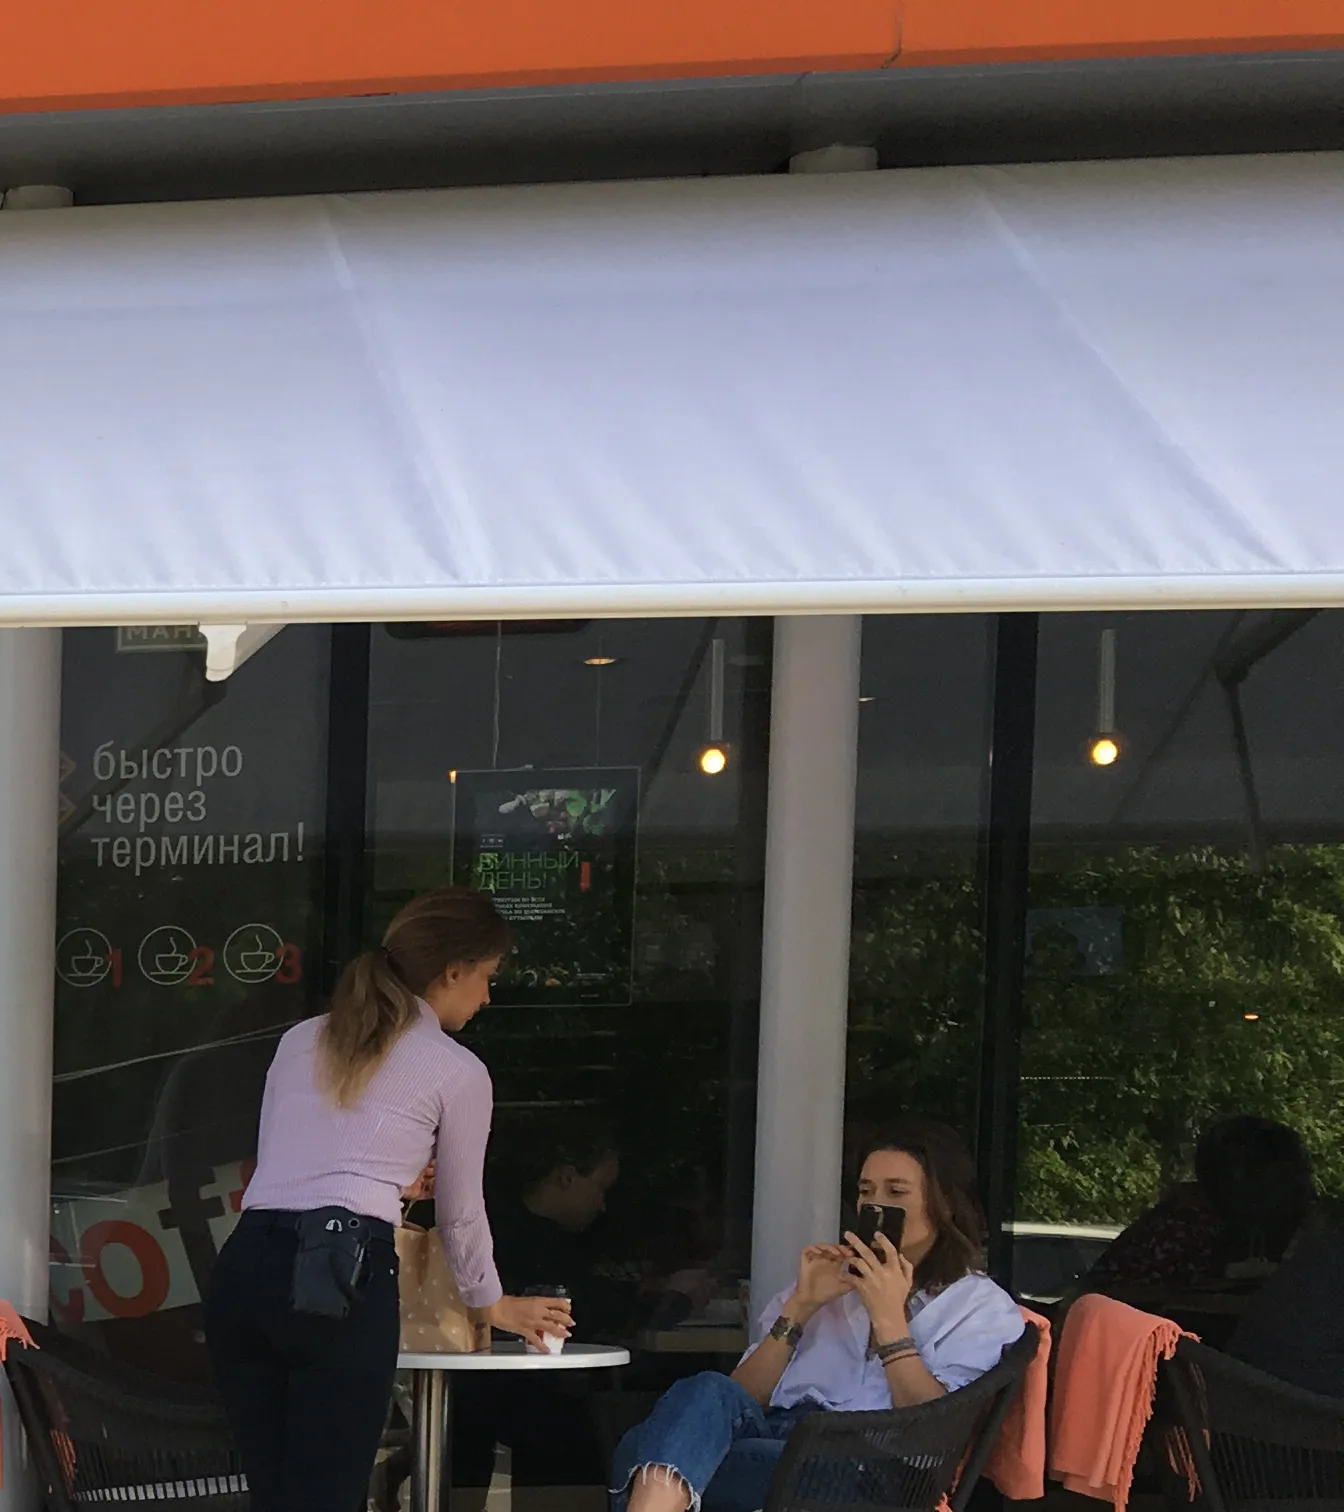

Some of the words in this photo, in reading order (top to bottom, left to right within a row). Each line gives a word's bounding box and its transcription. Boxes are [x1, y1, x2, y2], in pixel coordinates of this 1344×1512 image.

[126, 626, 204, 641] МАН
[92, 741, 243, 786] быстро
[92, 790, 207, 832] через
[91, 822, 305, 876] терминал!
[479, 851, 579, 870] ВИННЫЙ
[478, 872, 547, 891] ДЕНЬ!
[188, 946, 216, 987] 2
[274, 943, 302, 983] 3
